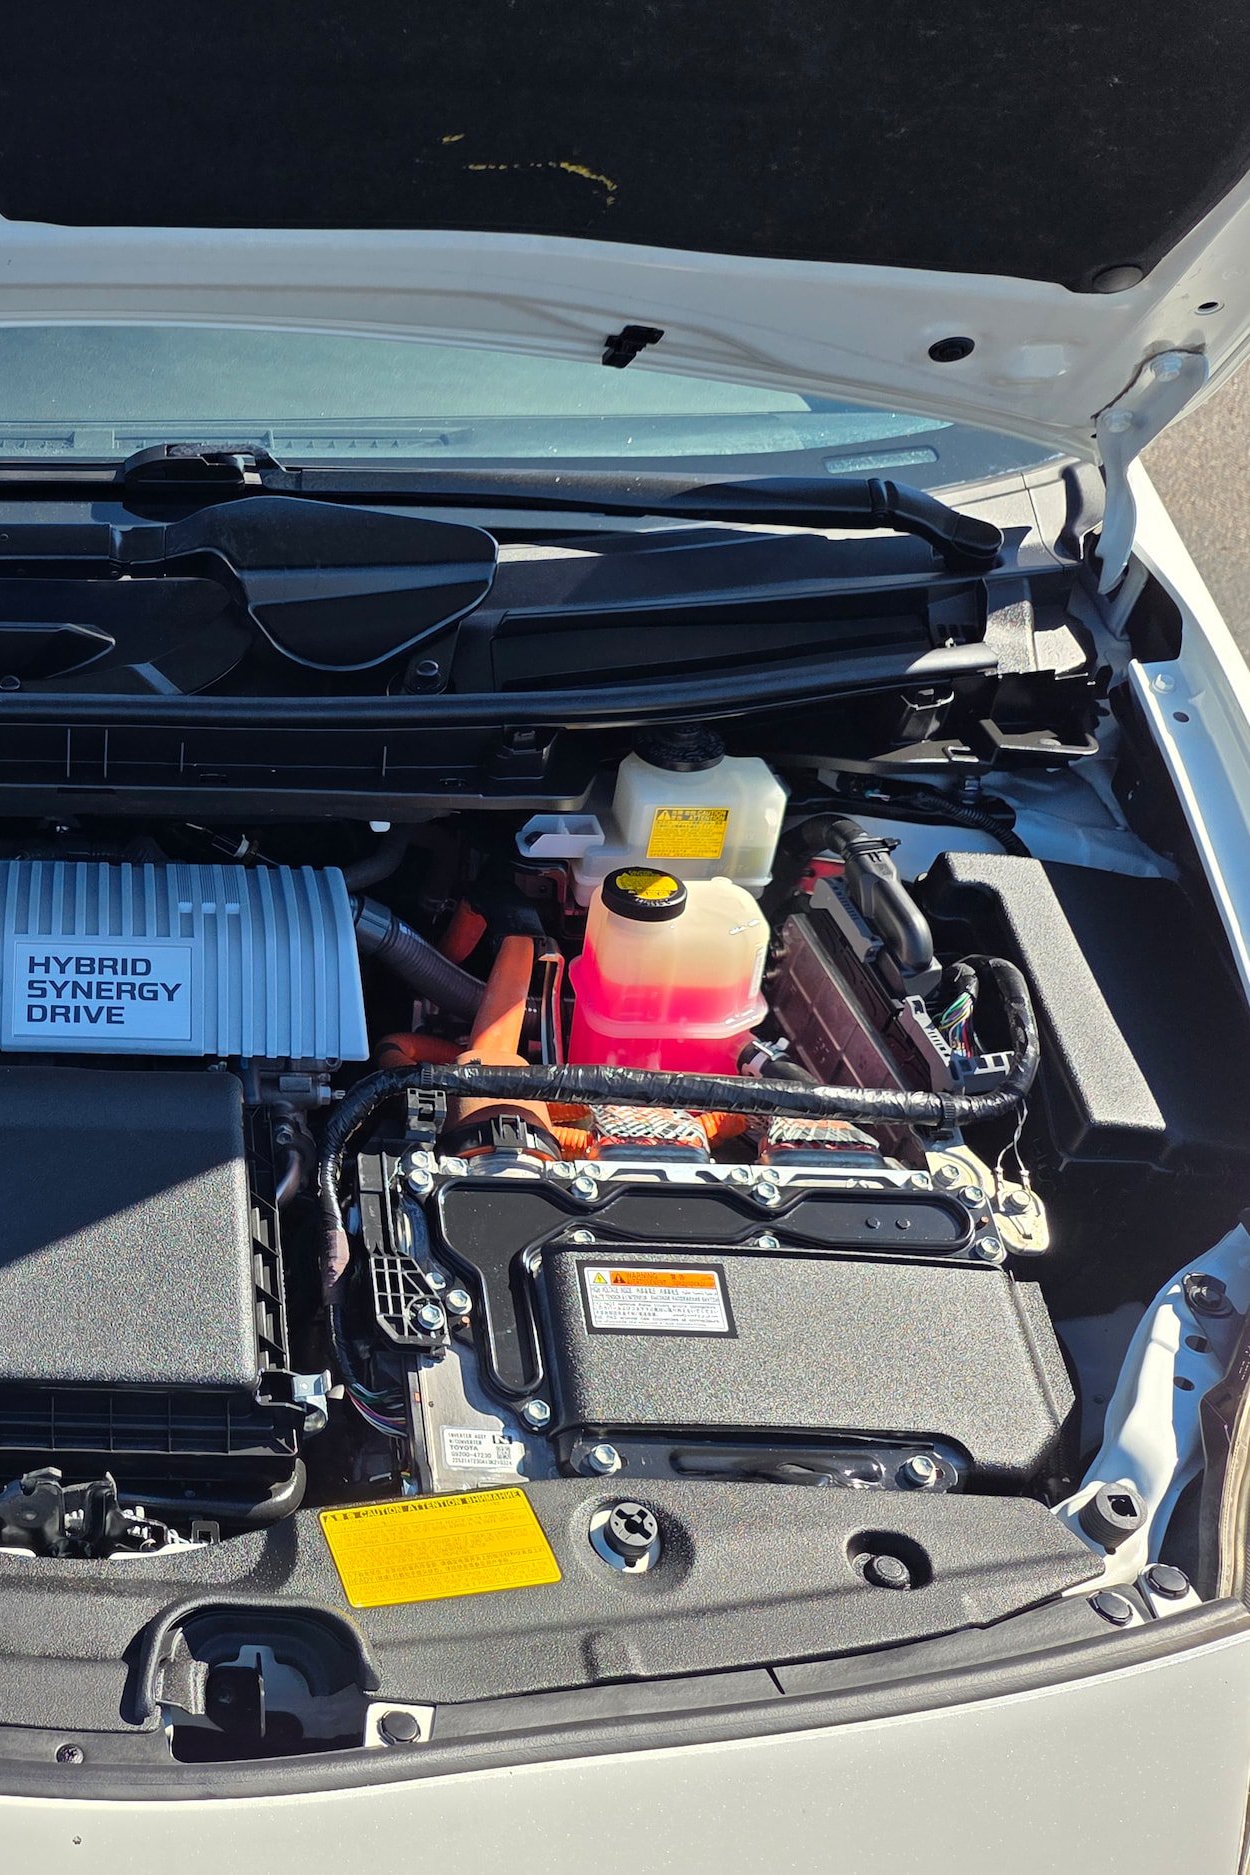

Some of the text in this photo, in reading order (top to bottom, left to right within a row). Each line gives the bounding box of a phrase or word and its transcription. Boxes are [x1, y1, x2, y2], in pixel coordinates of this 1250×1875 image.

[28, 956, 151, 976] HYBRID
[27, 980, 182, 1002] SYNERGY
[27, 1004, 125, 1024] DRIVE
[360, 1506, 403, 1518] CAUTION
[407, 1499, 462, 1512] ATTENTION
